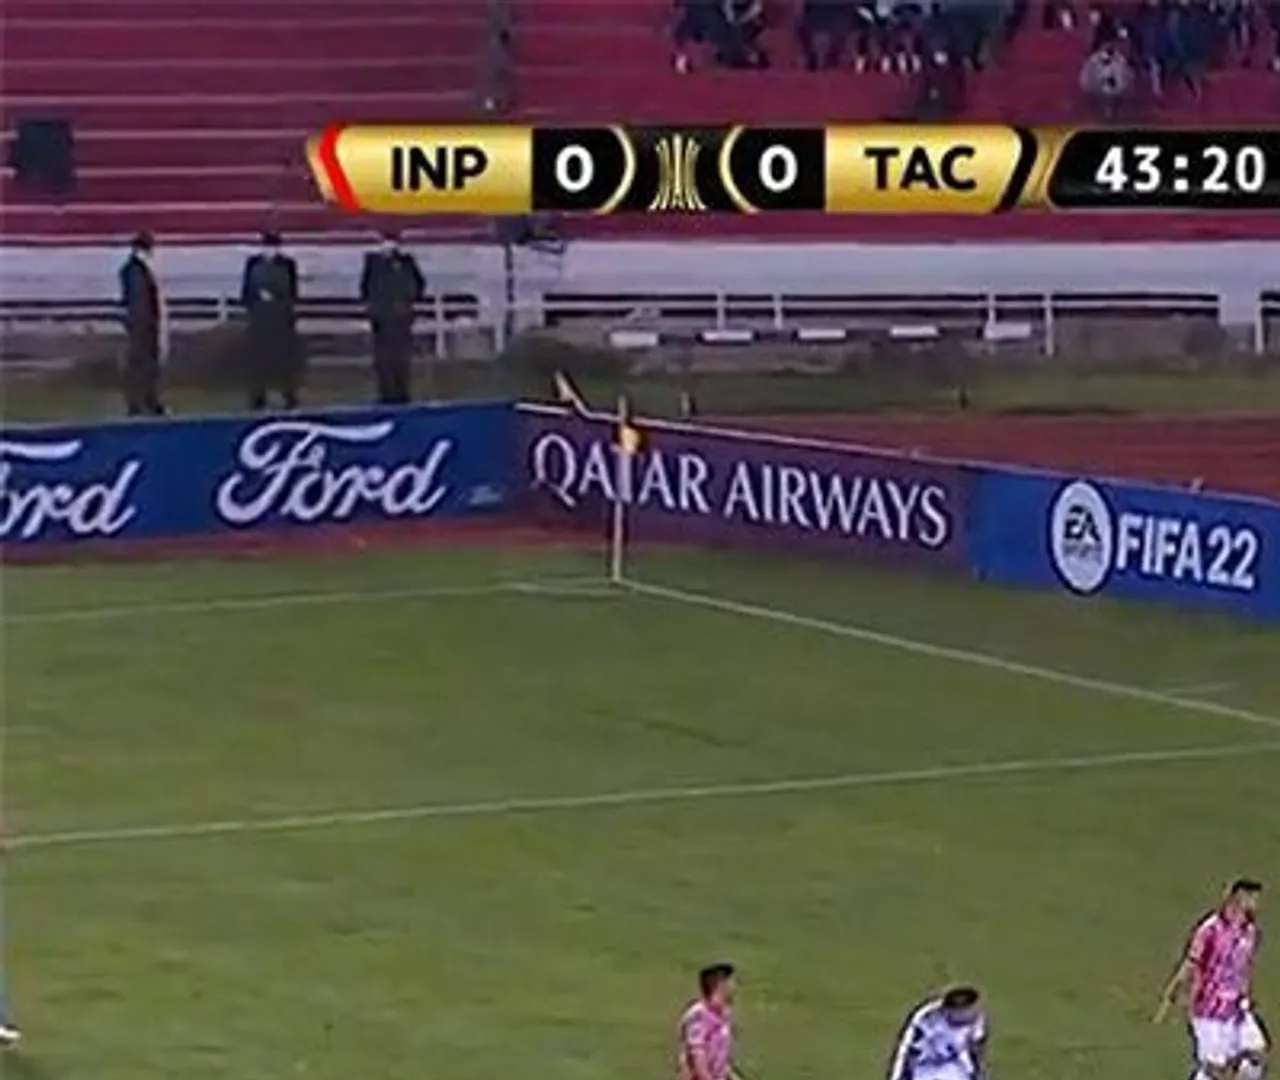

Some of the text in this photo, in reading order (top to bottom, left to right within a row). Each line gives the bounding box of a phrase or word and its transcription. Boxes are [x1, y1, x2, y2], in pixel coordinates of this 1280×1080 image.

[216, 420, 452, 523] Ford
[531, 433, 948, 547] QATAR AIRWAYS
[1115, 511, 1258, 590] FIFA 22
